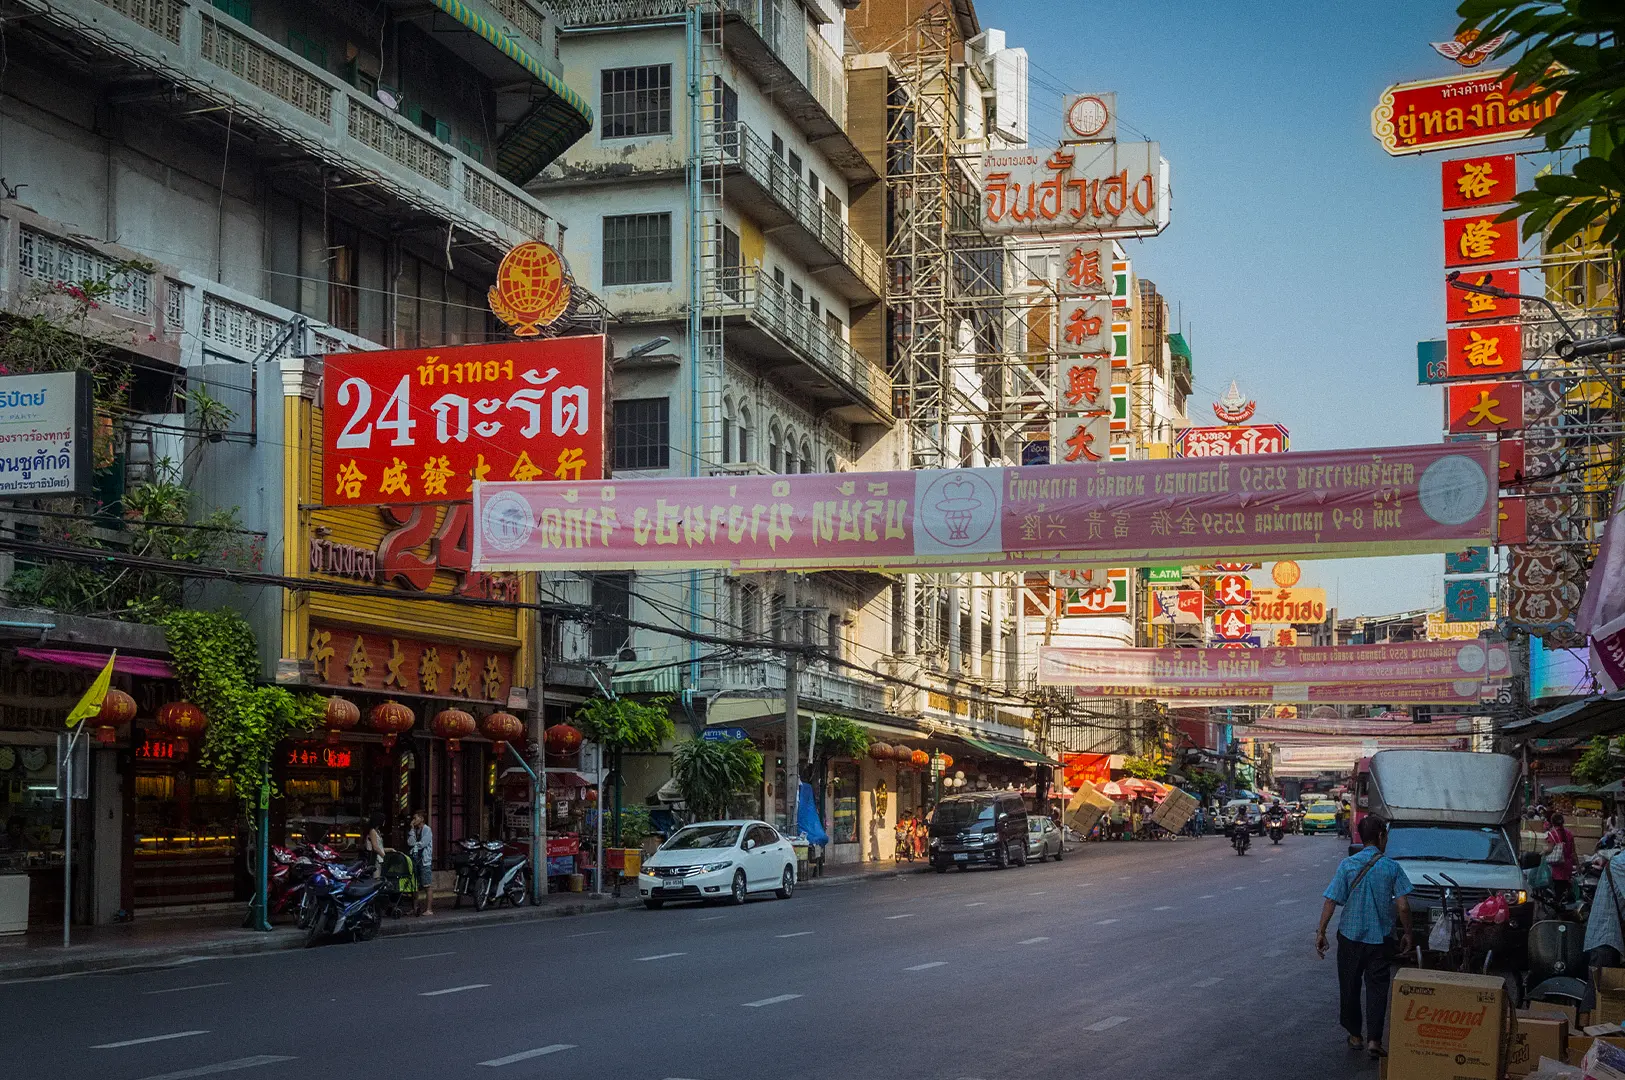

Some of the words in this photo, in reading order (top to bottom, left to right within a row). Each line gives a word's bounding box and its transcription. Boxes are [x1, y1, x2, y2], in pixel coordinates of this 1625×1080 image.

[1441, 81, 1503, 99] ห้างค้าทอง
[417, 355, 514, 386] ห้างทอง
[336, 374, 416, 449] 24
[430, 367, 589, 444] กะรัต
[1158, 570, 1181, 579] ATM
[1180, 597, 1199, 608] KFC
[736, 730, 742, 739] 8
[1404, 1000, 1487, 1027] Le-mond
